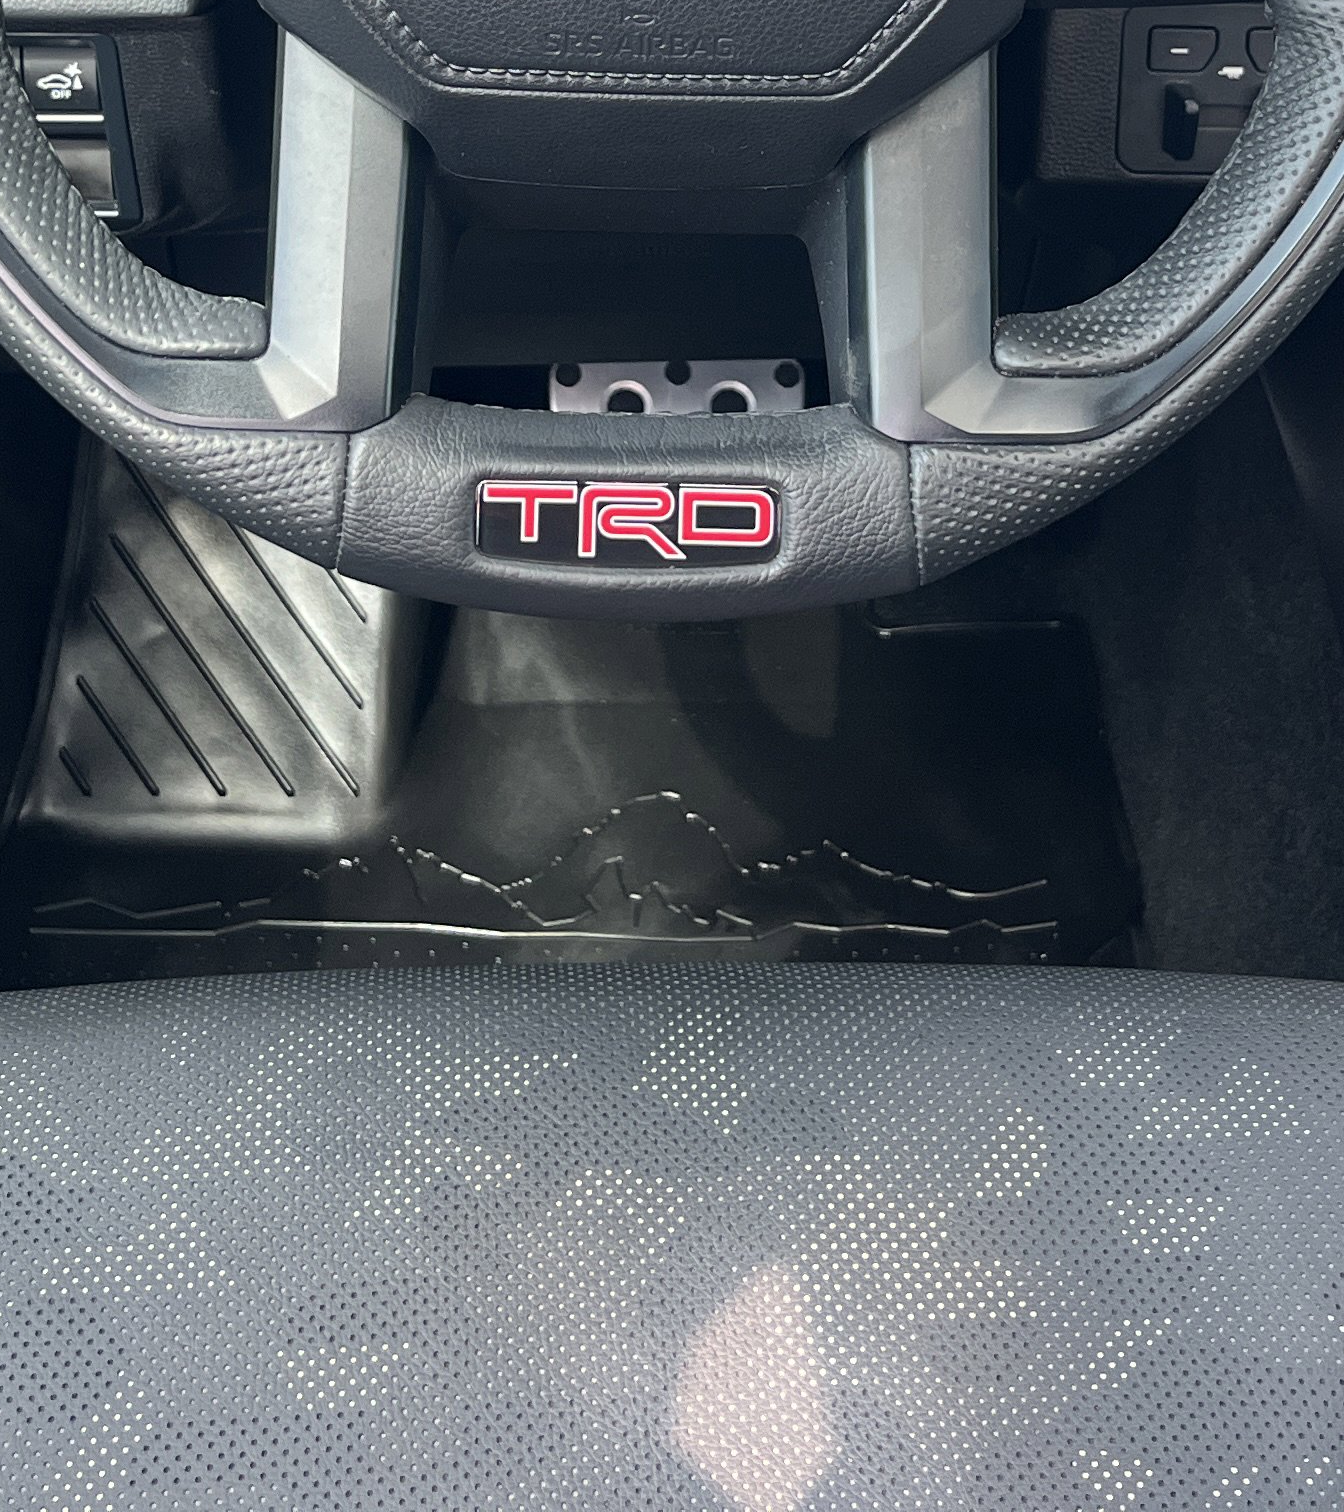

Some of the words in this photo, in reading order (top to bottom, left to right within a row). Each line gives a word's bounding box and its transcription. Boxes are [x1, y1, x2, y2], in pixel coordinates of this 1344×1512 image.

[544, 33, 604, 57] SRS
[611, 36, 735, 59] AIRBAG
[50, 89, 72, 100] OFF
[482, 484, 775, 560] TRD
